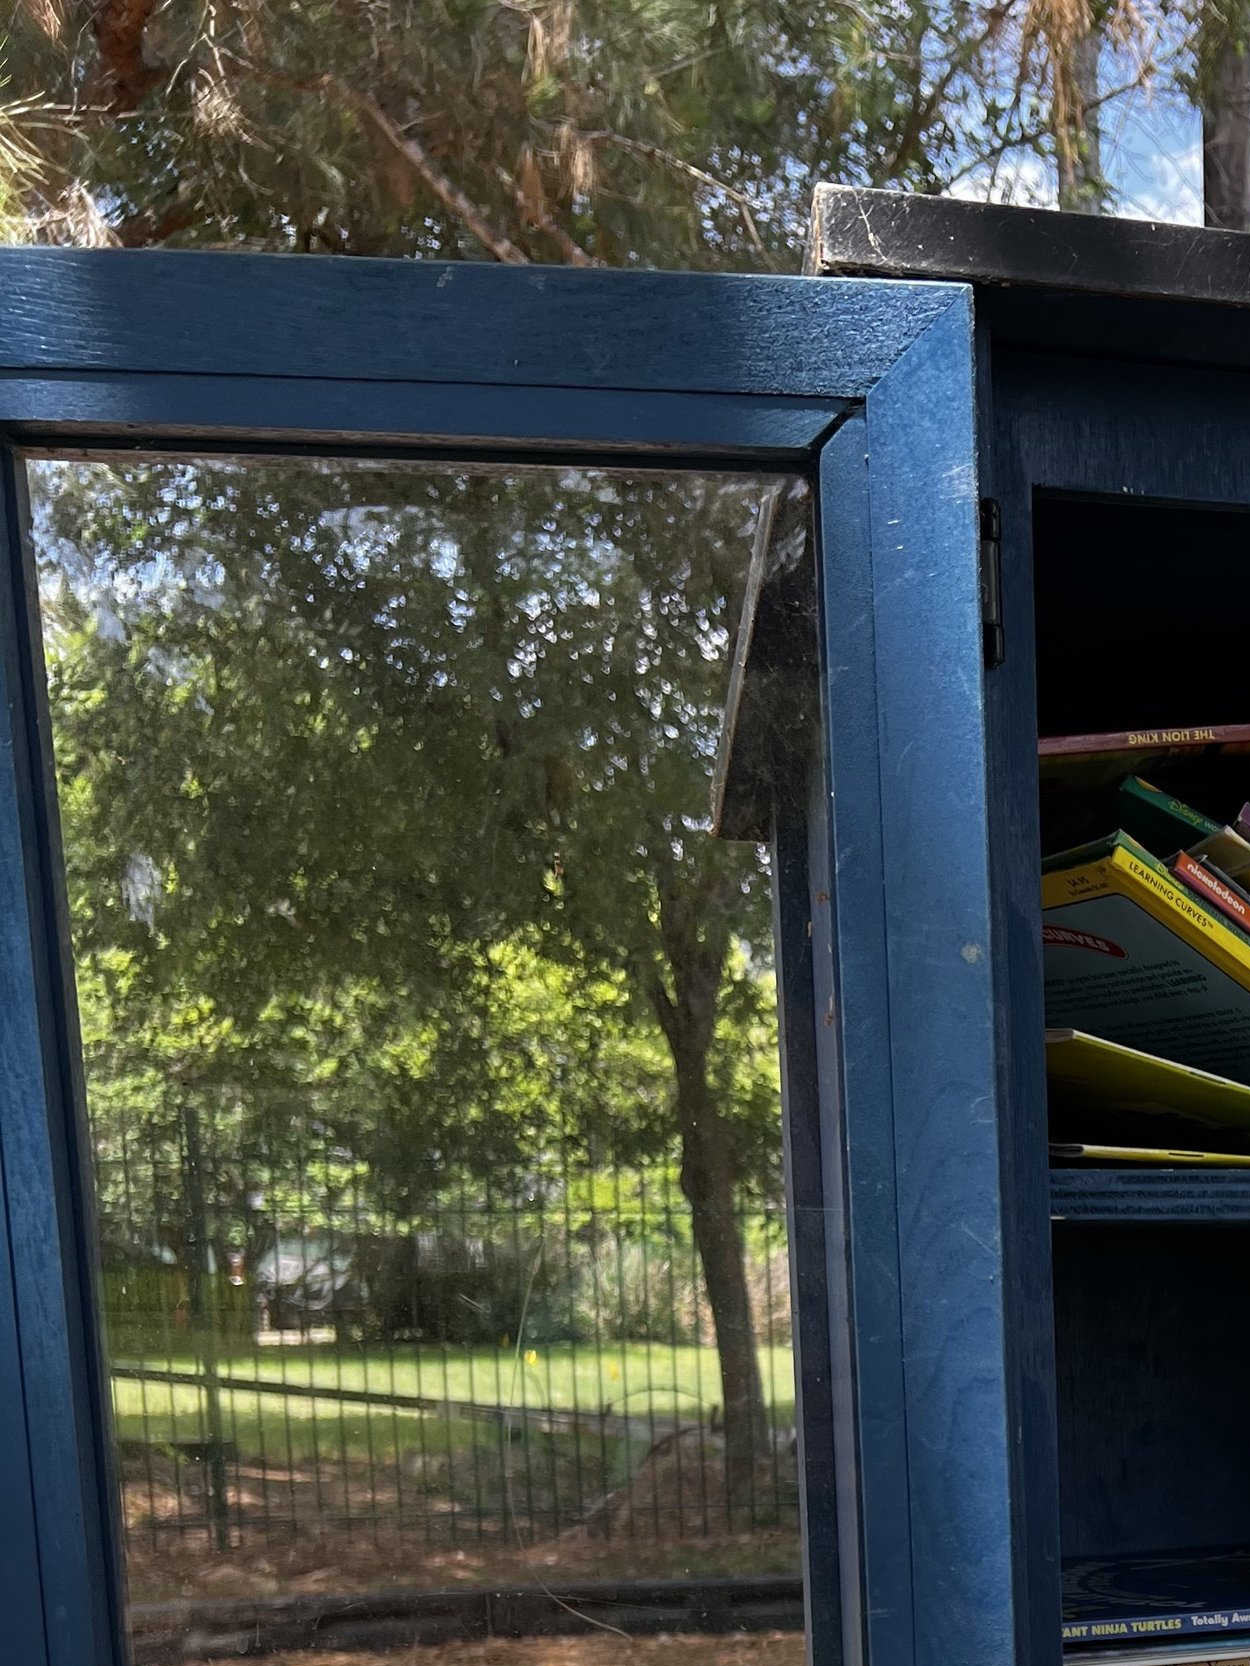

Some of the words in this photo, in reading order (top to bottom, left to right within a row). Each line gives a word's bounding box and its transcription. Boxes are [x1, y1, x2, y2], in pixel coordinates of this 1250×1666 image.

[1128, 733, 1159, 745] KING
[1162, 731, 1190, 742] LION
[1194, 729, 1215, 740] THE
[1128, 861, 1174, 907] LEARNING
[1187, 863, 1245, 915] nickelodeon
[1061, 1625, 1089, 1638] ANT
[1091, 1623, 1128, 1636] NINJA
[1131, 1618, 1182, 1632] TURTLES
[1191, 1613, 1230, 1627] Totally
